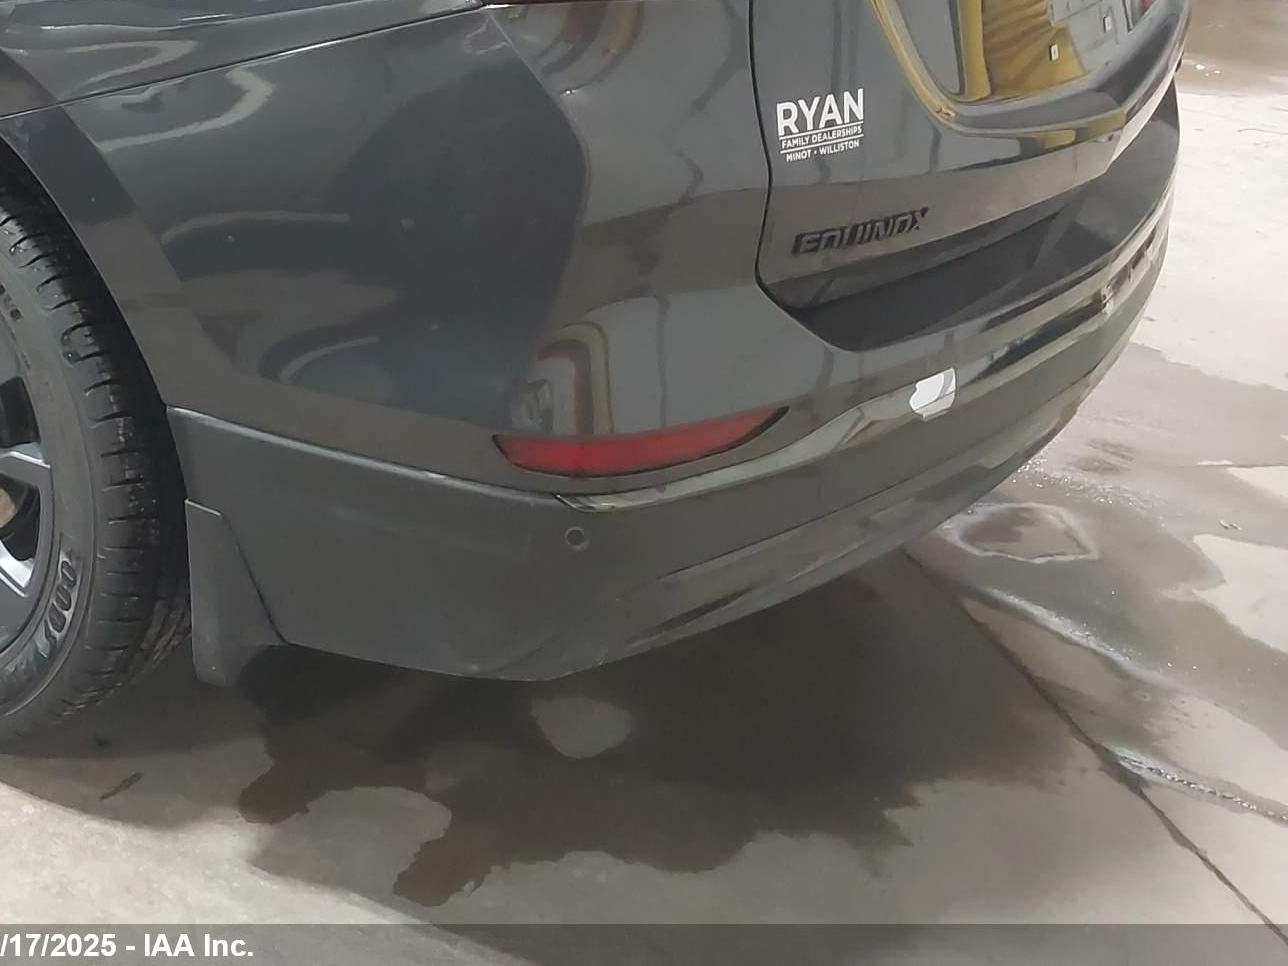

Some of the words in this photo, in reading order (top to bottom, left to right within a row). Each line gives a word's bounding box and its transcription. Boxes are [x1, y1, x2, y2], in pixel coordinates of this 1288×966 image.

[776, 88, 864, 136] RYAN
[782, 135, 810, 149] FAMILY
[812, 125, 862, 142] DEALERSHIPS
[786, 150, 812, 162] MINOT
[819, 139, 860, 155] WILLISTON
